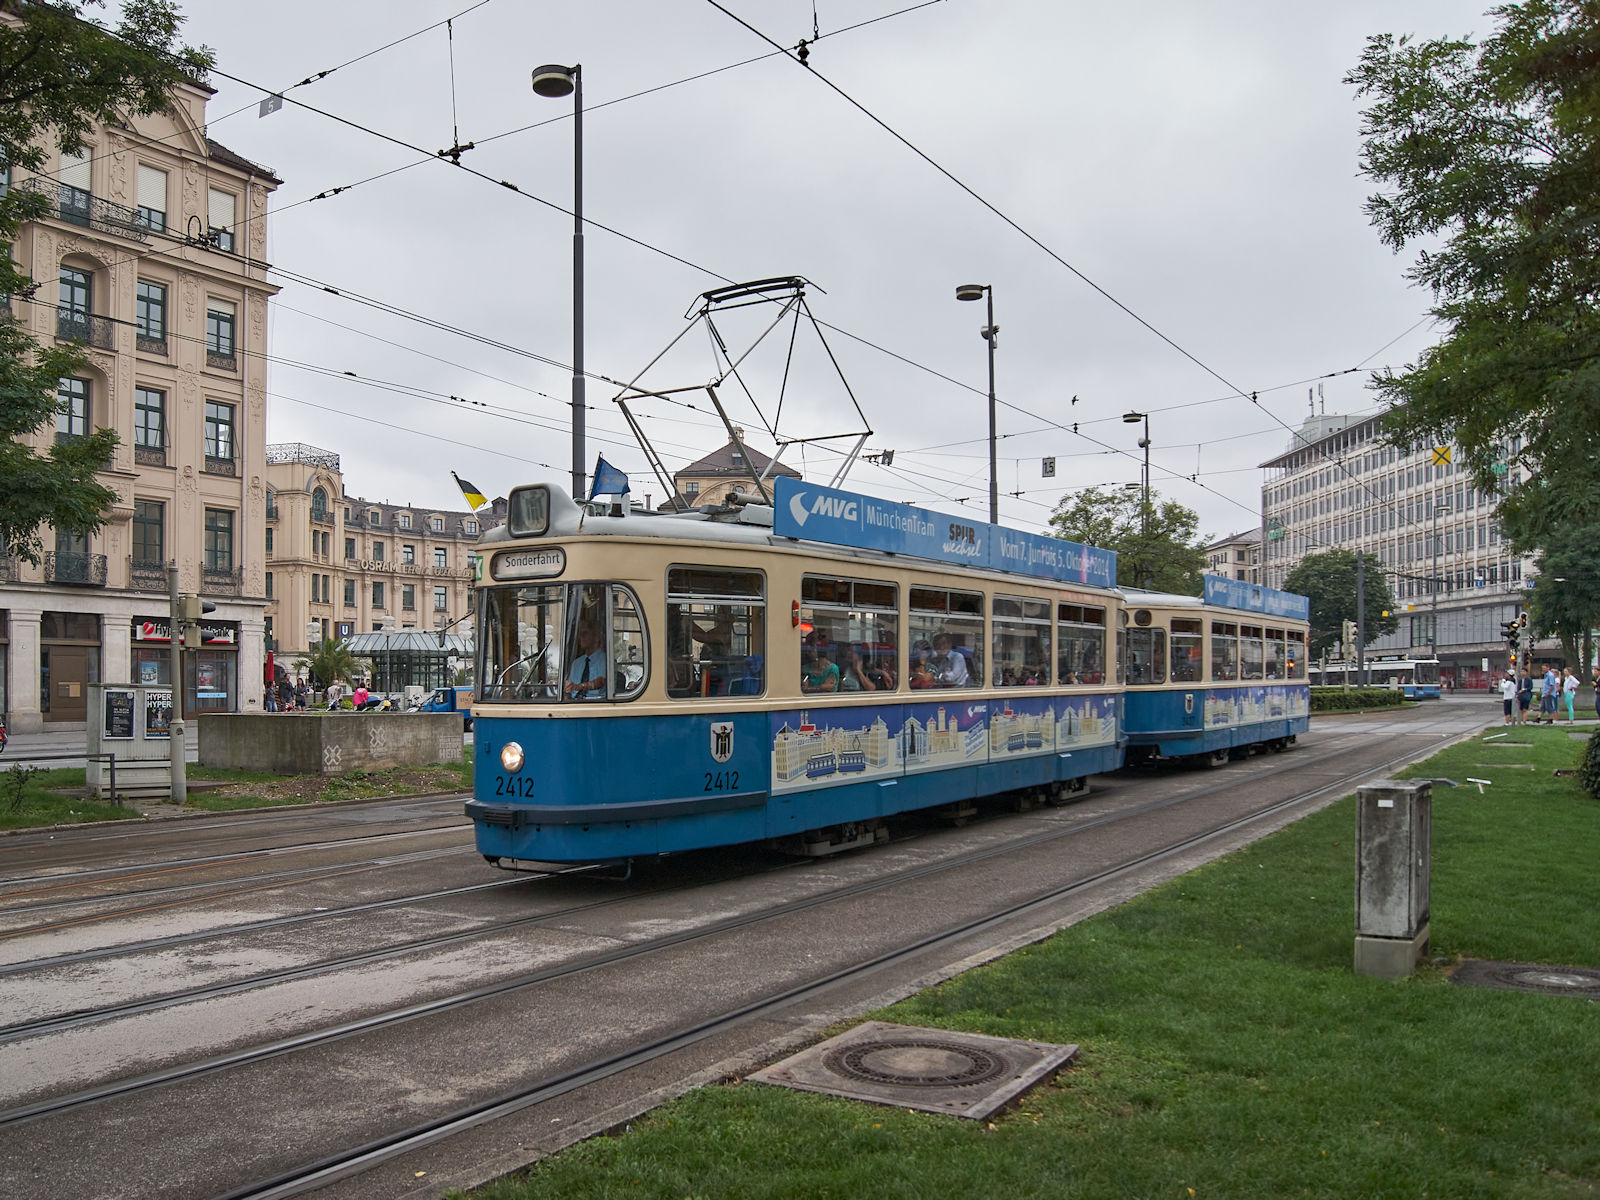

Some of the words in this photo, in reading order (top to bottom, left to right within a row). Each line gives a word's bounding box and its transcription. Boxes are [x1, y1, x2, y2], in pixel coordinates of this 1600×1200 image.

[810, 495, 857, 522] MVG
[866, 505, 935, 537] MünchenTram
[949, 523, 976, 545] SPUR
[942, 537, 982, 557] wechsel
[1000, 537, 1019, 561] Vom
[1020, 543, 1027, 561] 7.
[361, 560, 398, 572] OSRAM
[505, 553, 560, 568] Sonderfahrt
[341, 625, 348, 635] U
[147, 693, 172, 701] HYPER
[147, 700, 172, 708] HYPER
[495, 775, 535, 798] 2412
[704, 772, 739, 791] 2412
